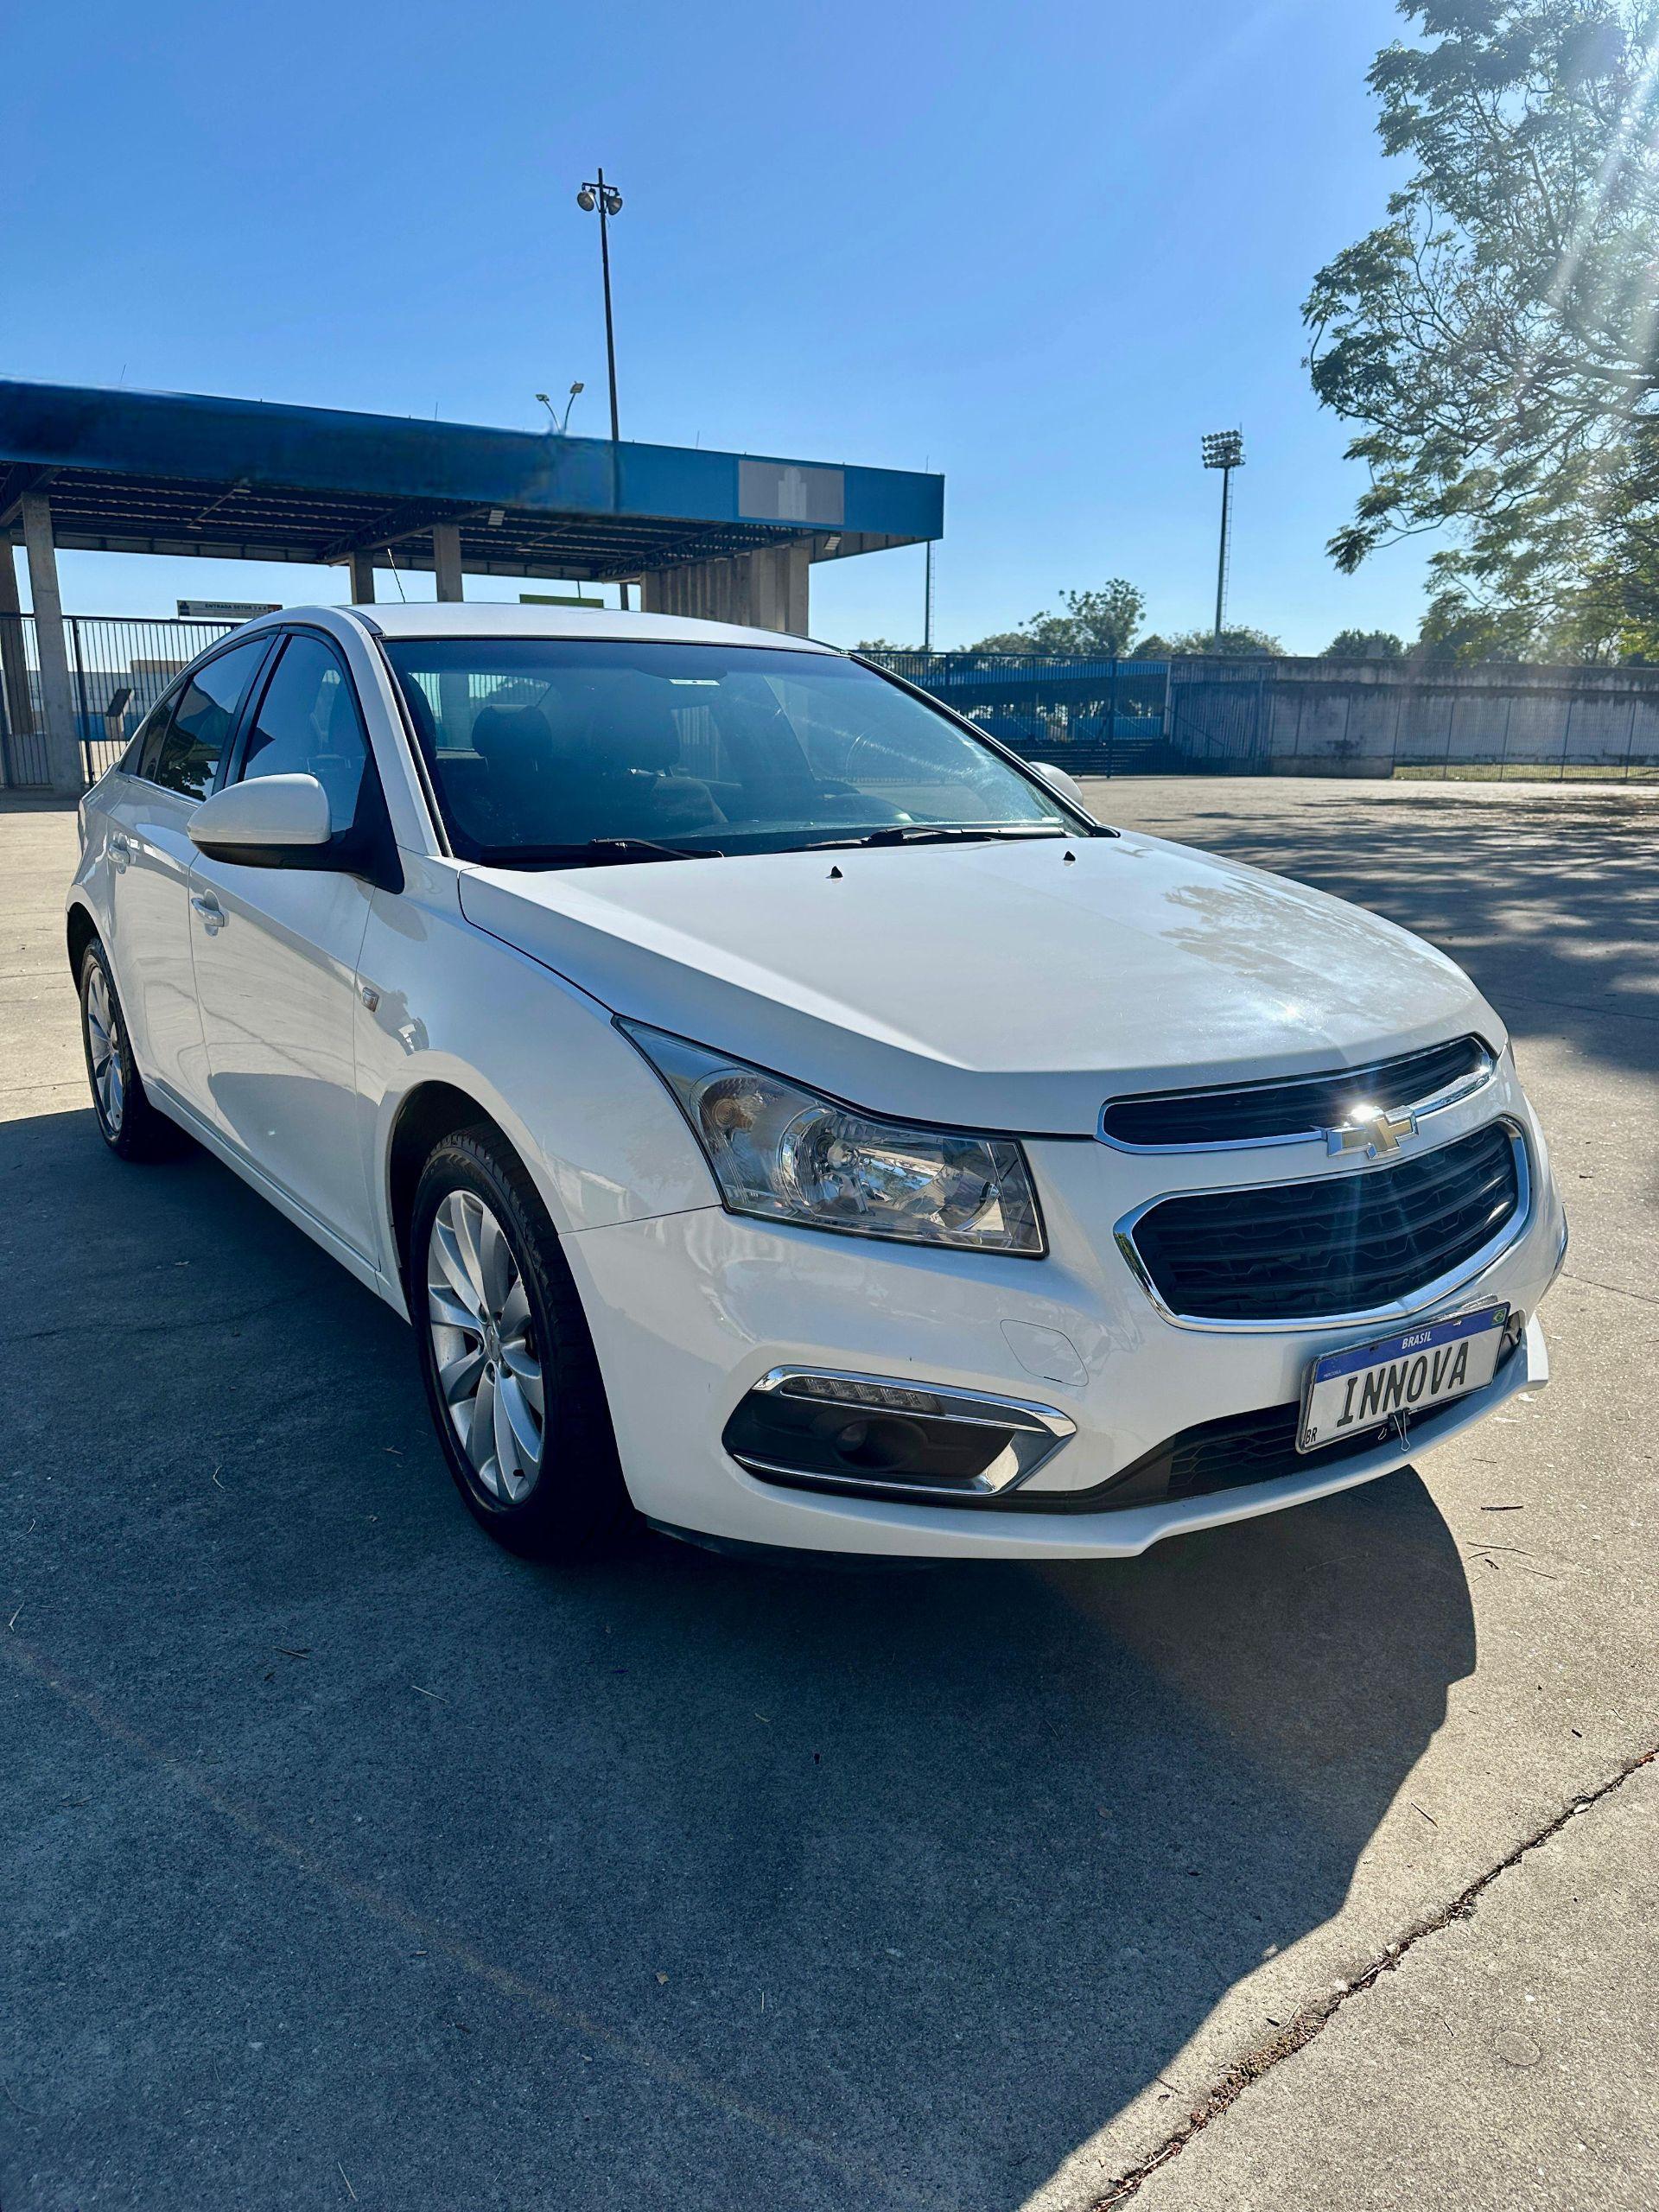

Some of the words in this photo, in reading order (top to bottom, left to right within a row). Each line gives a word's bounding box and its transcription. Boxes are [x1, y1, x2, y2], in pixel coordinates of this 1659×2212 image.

[1402, 1332, 1432, 1350] BRASIL
[1337, 1341, 1469, 1428] INNOVA
[1305, 1427, 1318, 1444] BR
